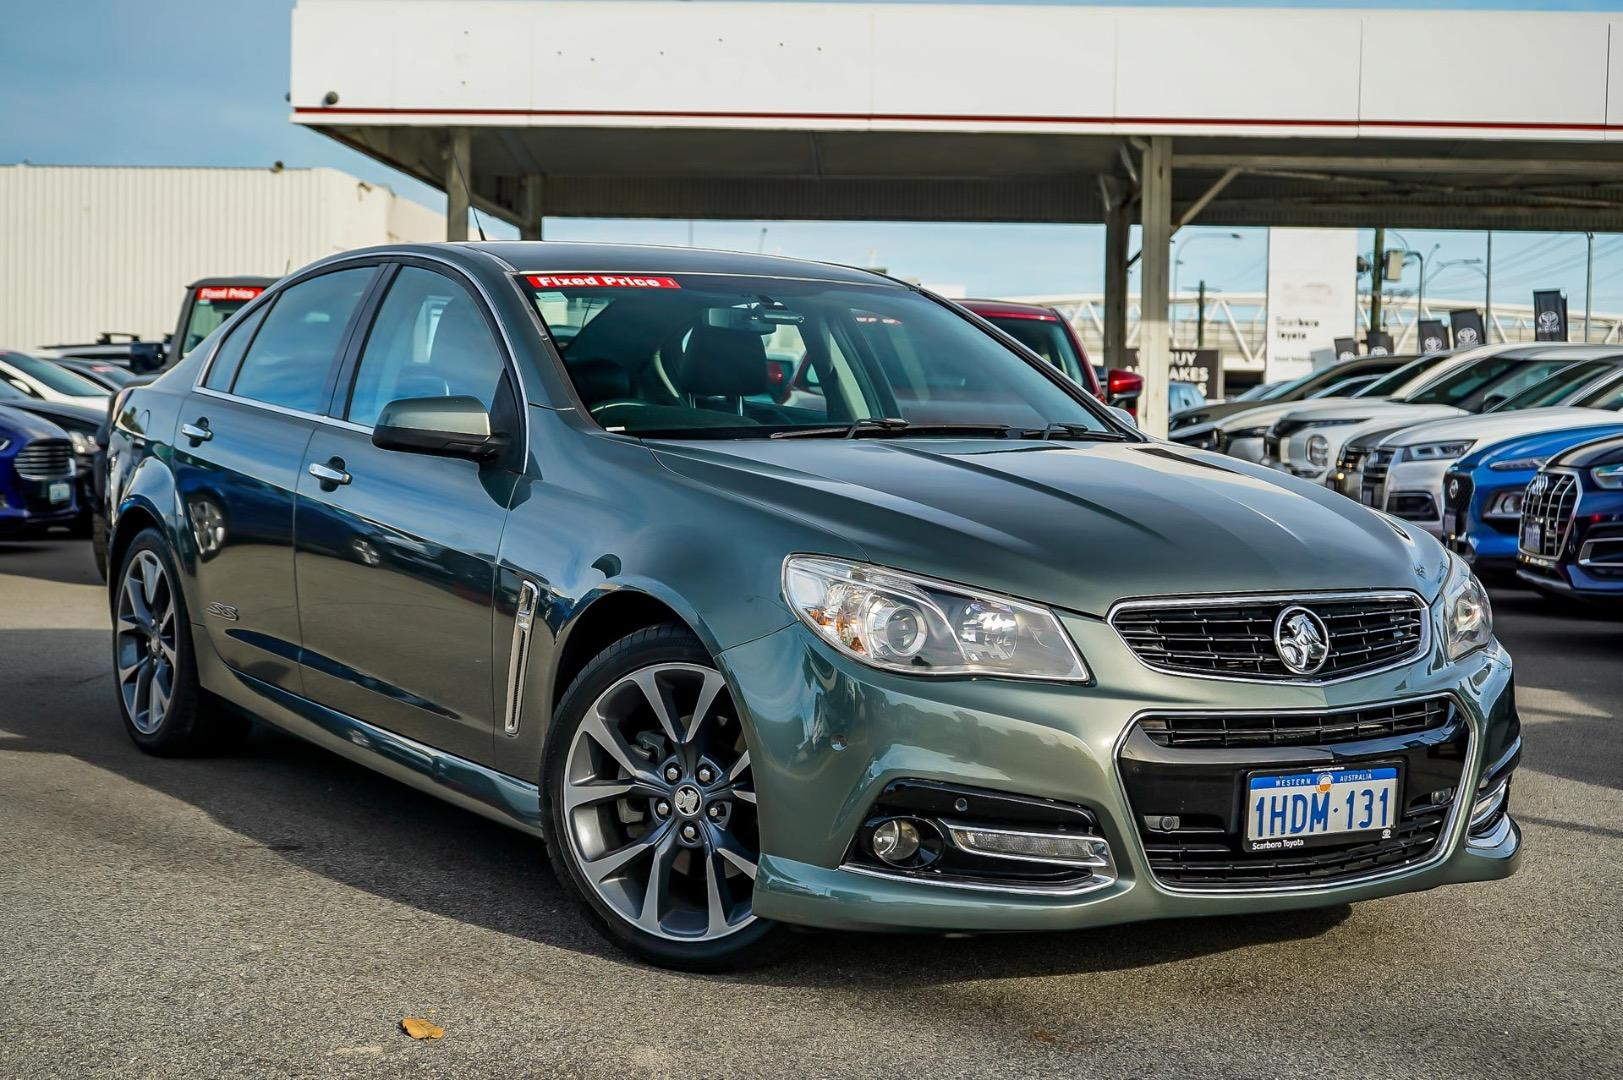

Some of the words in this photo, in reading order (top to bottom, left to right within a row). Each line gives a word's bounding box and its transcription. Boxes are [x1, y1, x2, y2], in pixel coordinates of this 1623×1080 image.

[539, 276, 599, 287] Fixed
[601, 277, 661, 288] Price
[1169, 366, 1209, 382] AKES
[1275, 778, 1311, 787] WESTERN
[1339, 773, 1373, 783] AUSTRALIA
[1252, 840, 1282, 850] Scarboro
[1283, 839, 1304, 848] Toyota
